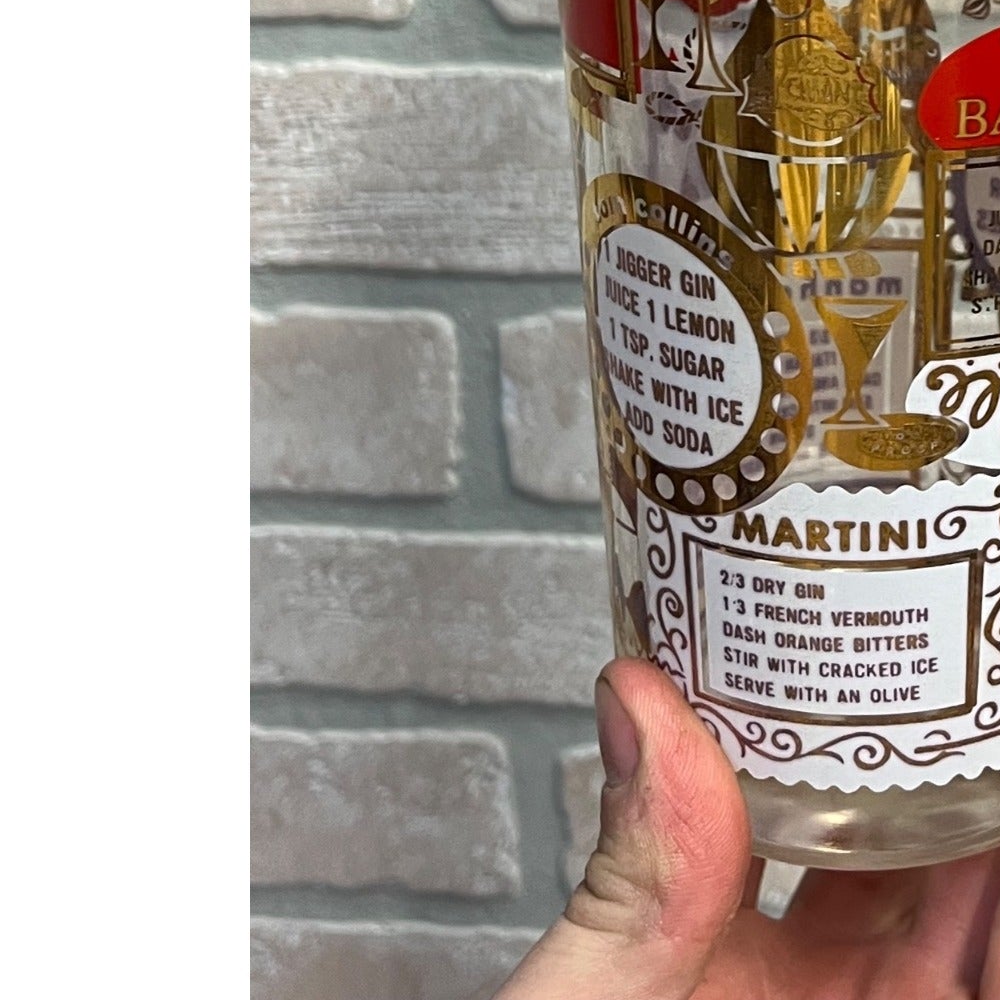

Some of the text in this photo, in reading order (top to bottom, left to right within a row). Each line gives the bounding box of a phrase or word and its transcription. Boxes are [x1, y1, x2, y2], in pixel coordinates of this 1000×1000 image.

[635, 197, 735, 272] collins
[604, 238, 716, 301] 1 JIGGER GIN
[647, 299, 655, 323] 1
[664, 304, 736, 345] LEMON
[609, 317, 725, 382] 1 TSP. SUGAR
[651, 377, 698, 415] WITH
[708, 395, 744, 426] ICE
[624, 401, 714, 457] ADD SODA
[732, 511, 927, 552] MARTINI
[752, 576, 786, 596] DRY
[794, 583, 825, 601] GIN
[755, 602, 822, 626] FRENCH
[831, 607, 929, 627] VERMOUTH
[722, 621, 929, 653] DASH ORANGE BITTERS
[724, 646, 939, 678] STIR WITH CRACKED ICE
[725, 672, 920, 703] SERVE WITH AN OLIVE
